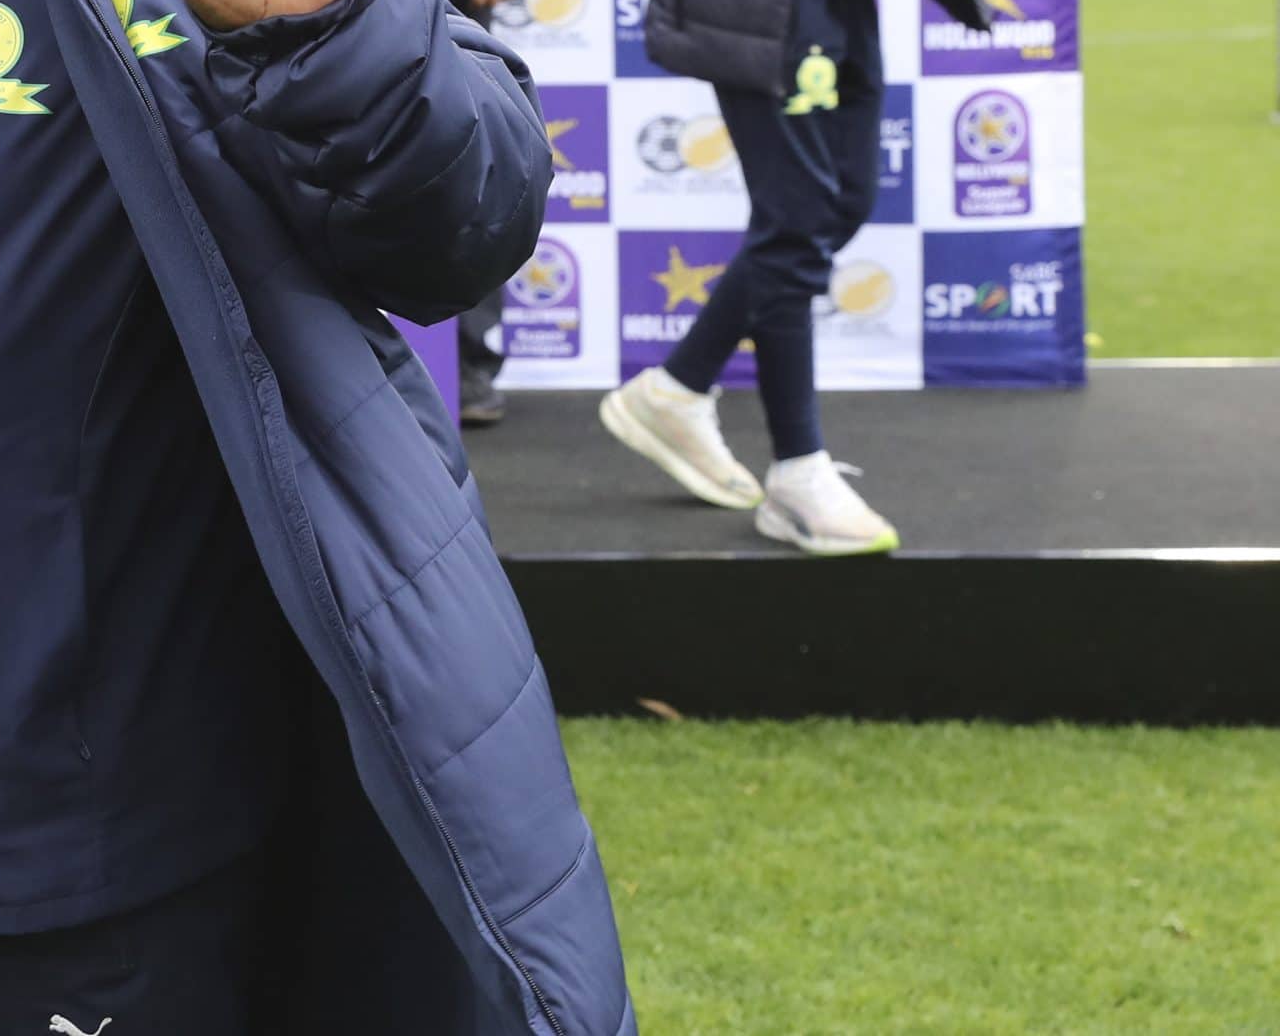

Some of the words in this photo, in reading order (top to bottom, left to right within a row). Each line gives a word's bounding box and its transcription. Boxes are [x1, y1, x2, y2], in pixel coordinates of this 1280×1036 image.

[966, 184, 1020, 201] Super
[1009, 260, 1062, 282] SABC
[924, 282, 1064, 318] SPORT
